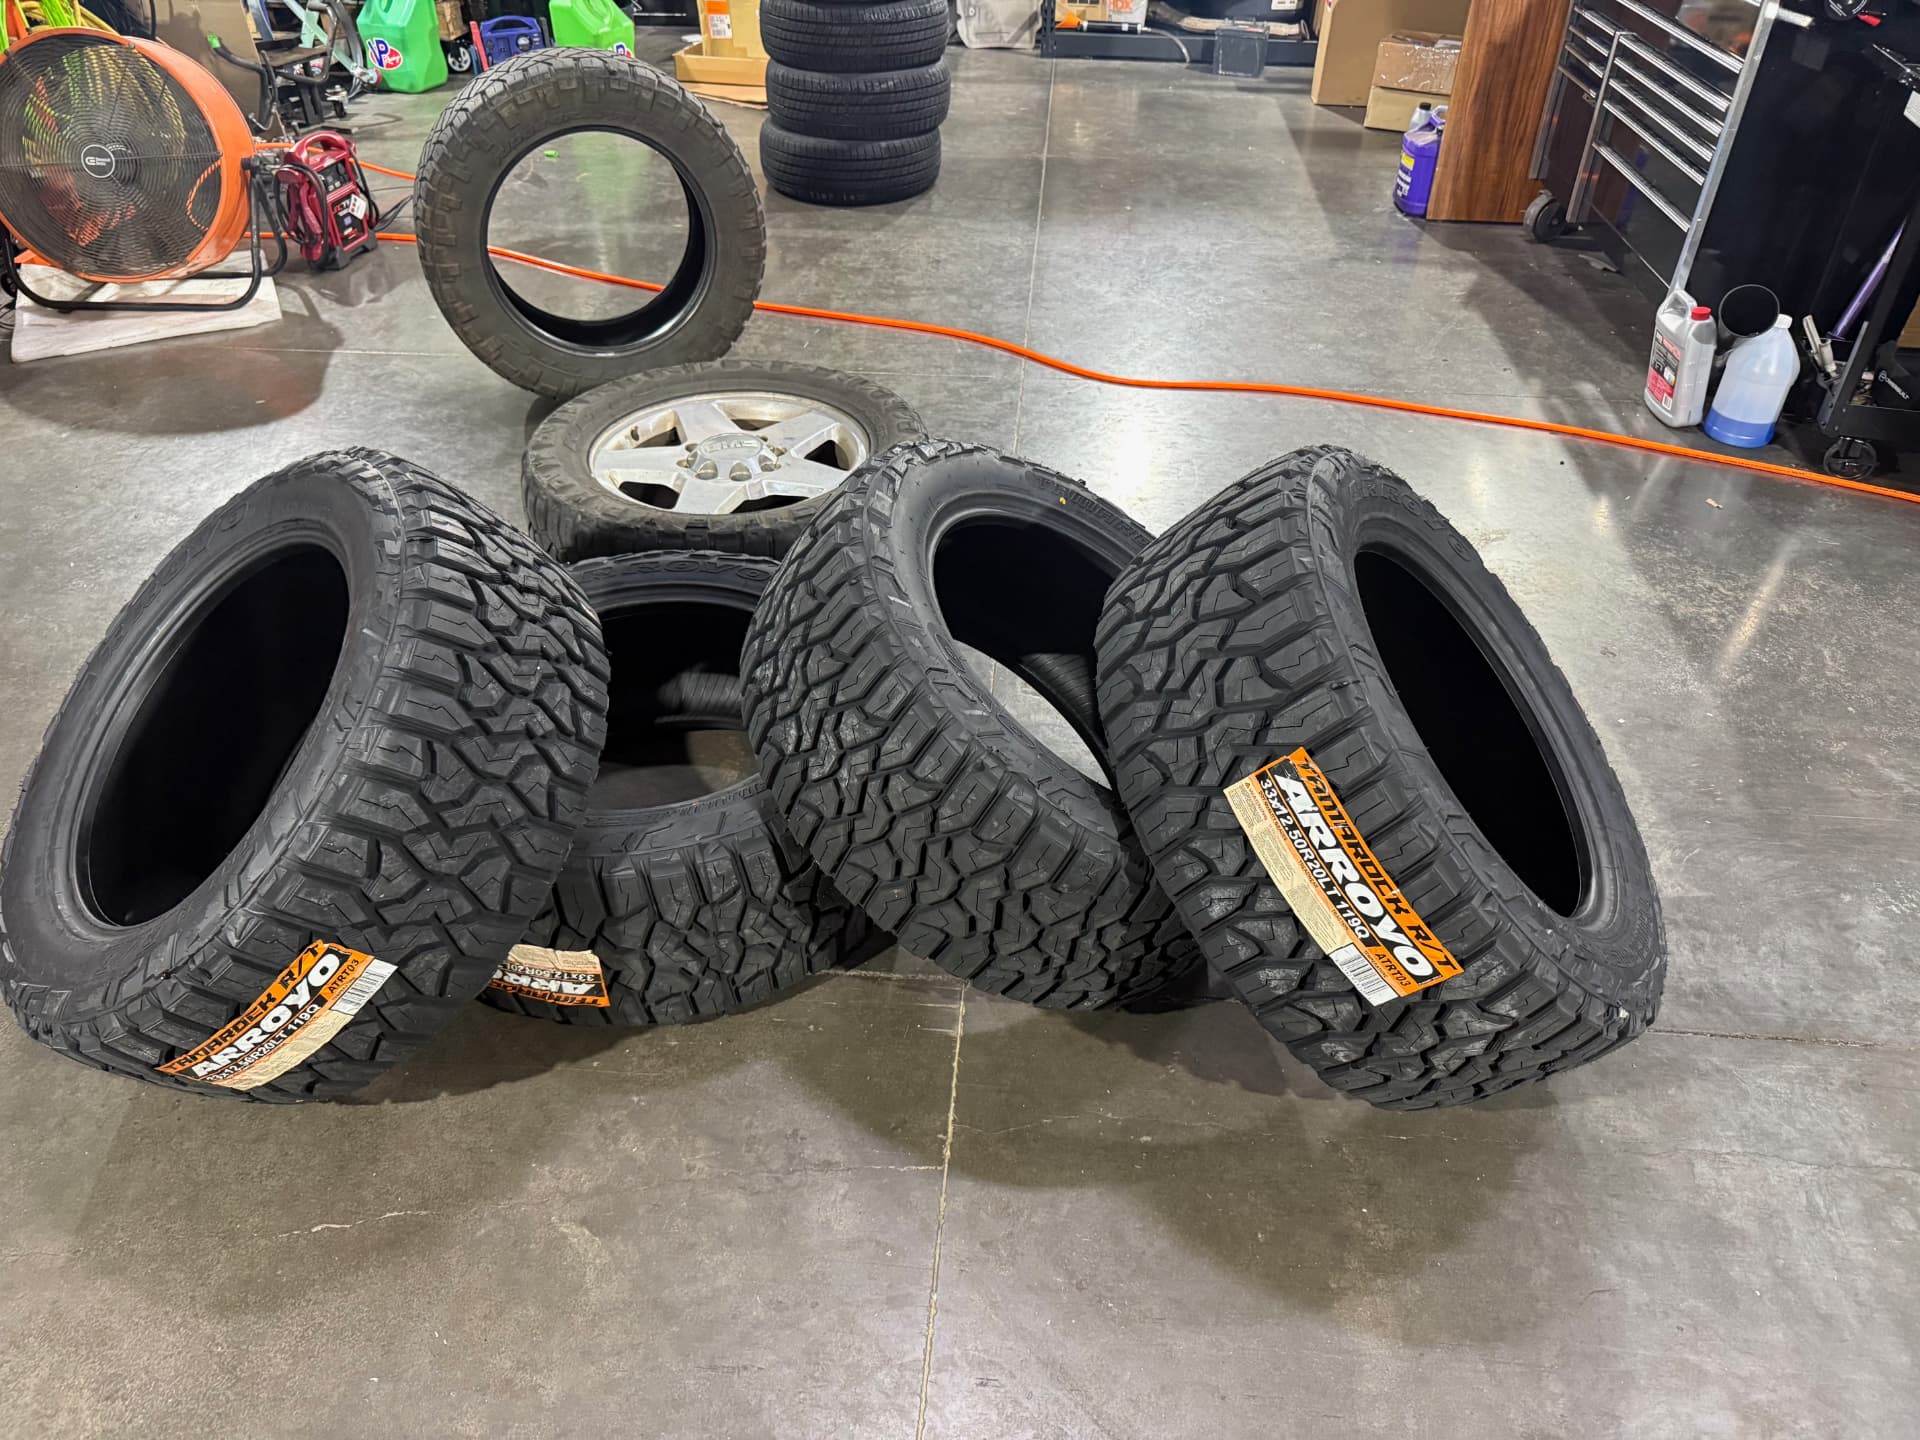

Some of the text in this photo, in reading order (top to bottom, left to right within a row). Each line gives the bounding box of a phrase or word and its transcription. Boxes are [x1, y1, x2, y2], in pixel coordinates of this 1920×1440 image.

[367, 38, 389, 68] VP
[705, 440, 759, 453] GMC
[1260, 778, 1342, 897] 33x12.50R20LT
[1336, 900, 1370, 940] 119Q
[1274, 774, 1433, 976] ARROYO
[278, 943, 320, 990] R/T
[1408, 925, 1457, 971] R/T
[328, 959, 360, 994] ATRT03
[1375, 953, 1411, 987] ATRT03
[191, 953, 340, 1078] ARROYO
[287, 1004, 322, 1032] 119Q
